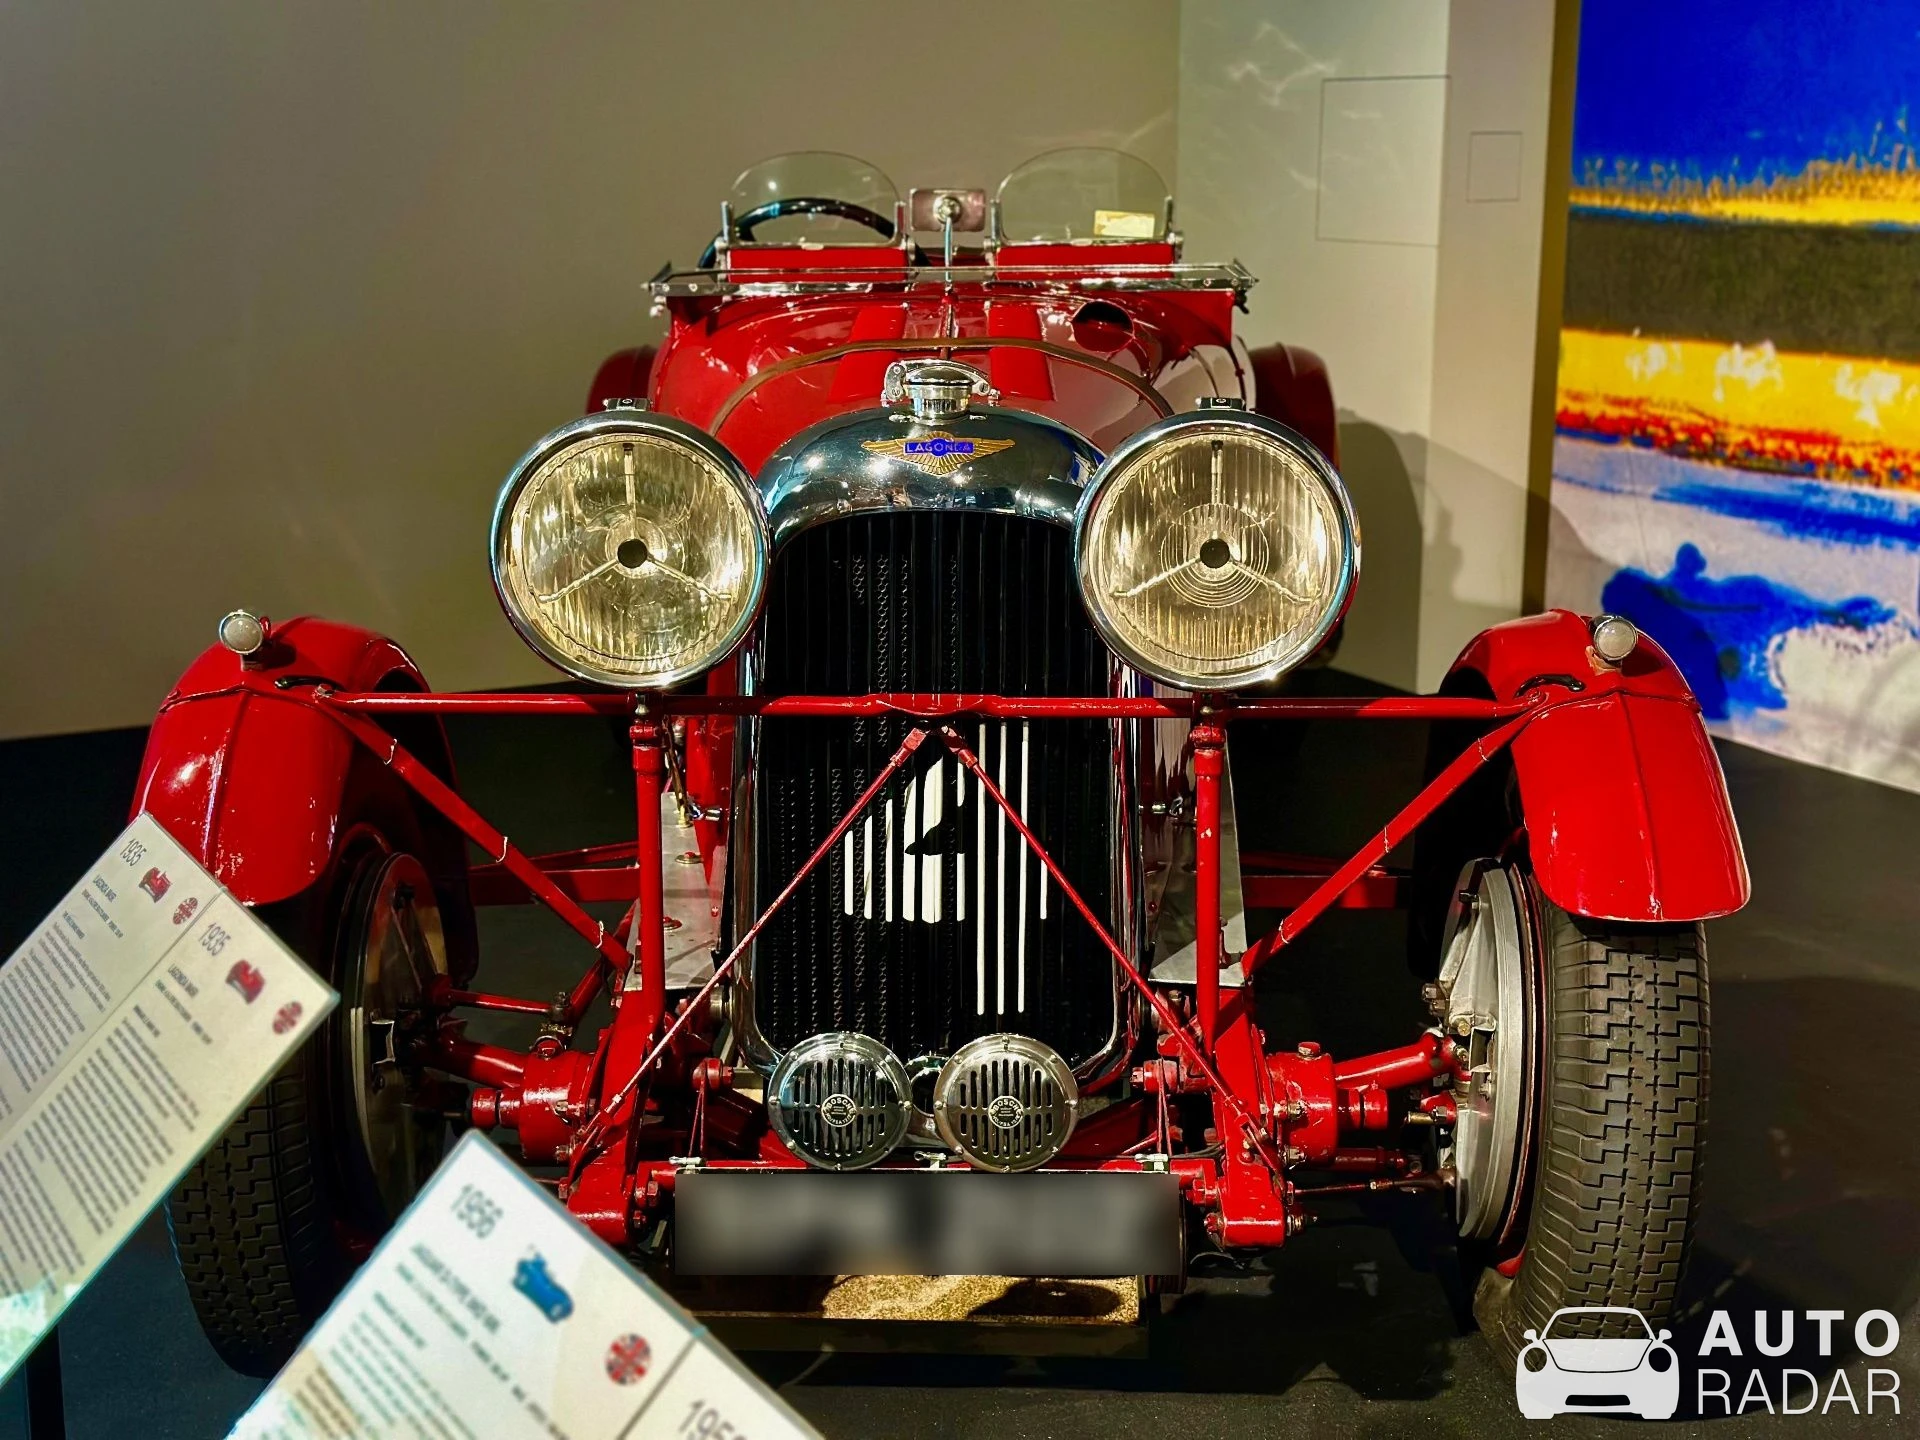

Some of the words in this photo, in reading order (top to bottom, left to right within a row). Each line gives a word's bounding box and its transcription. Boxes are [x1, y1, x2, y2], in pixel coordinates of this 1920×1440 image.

[119, 838, 148, 868] 1935
[198, 922, 232, 957] 1935
[825, 1097, 853, 1111] BOSCH
[992, 1098, 1020, 1112] BOSCH
[450, 1183, 504, 1240] 1956
[679, 1399, 748, 1440] 195
